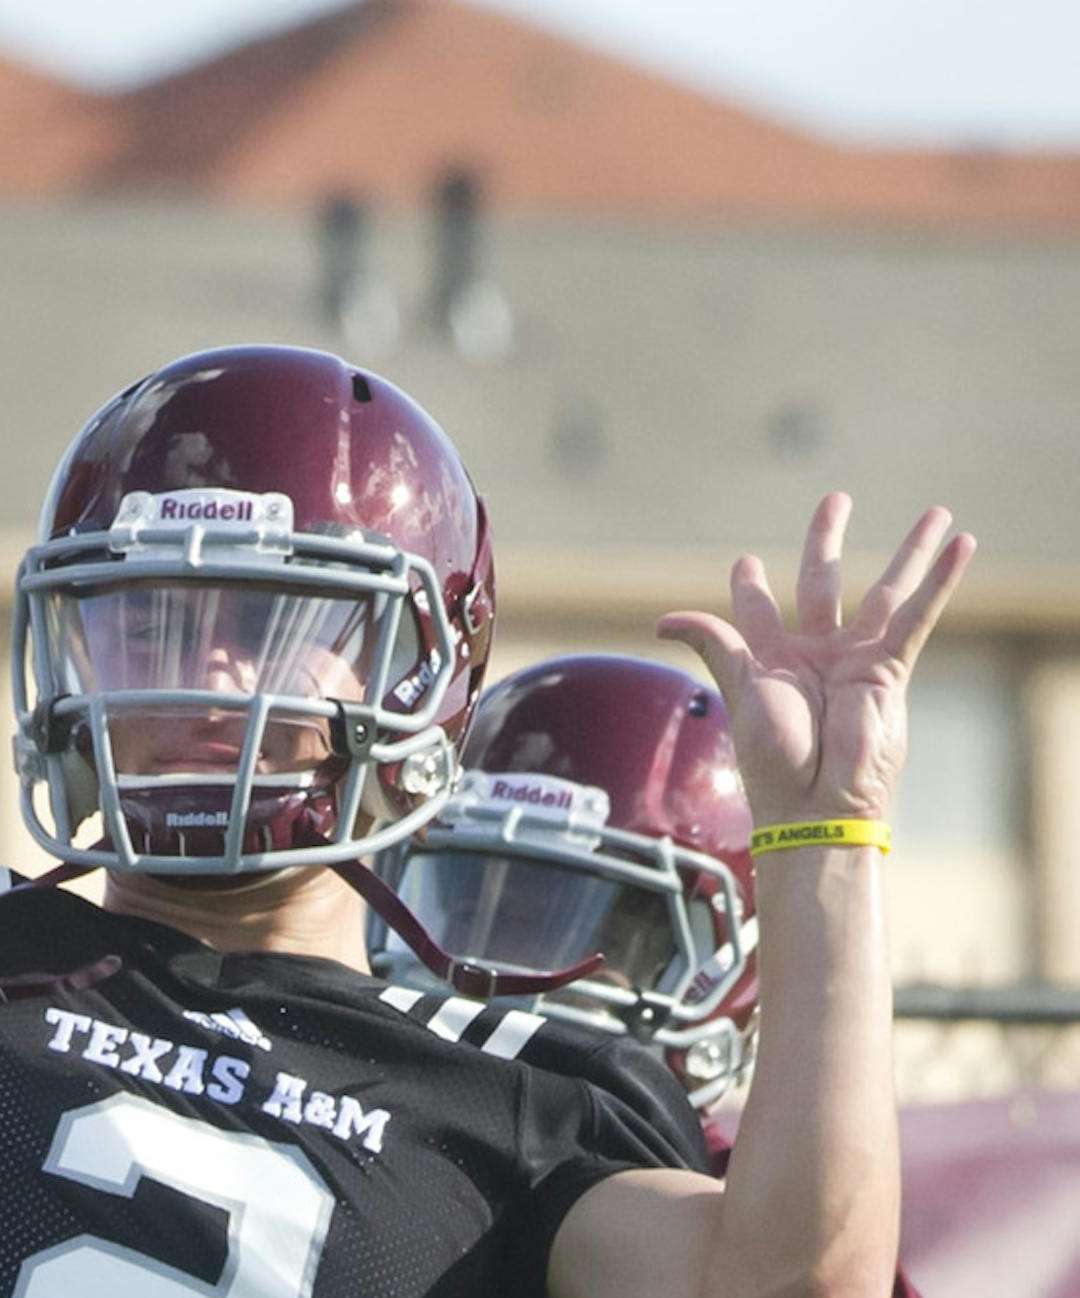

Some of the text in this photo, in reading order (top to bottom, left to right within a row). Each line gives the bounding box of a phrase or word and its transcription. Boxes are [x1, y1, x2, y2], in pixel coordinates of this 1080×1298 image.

[160, 498, 254, 521] Riddell
[490, 780, 574, 809] Riddell
[166, 811, 229, 828] Riddell
[777, 825, 845, 843] ANGELS
[45, 1007, 251, 1105] TEXAS
[261, 1071, 392, 1155] A&M
